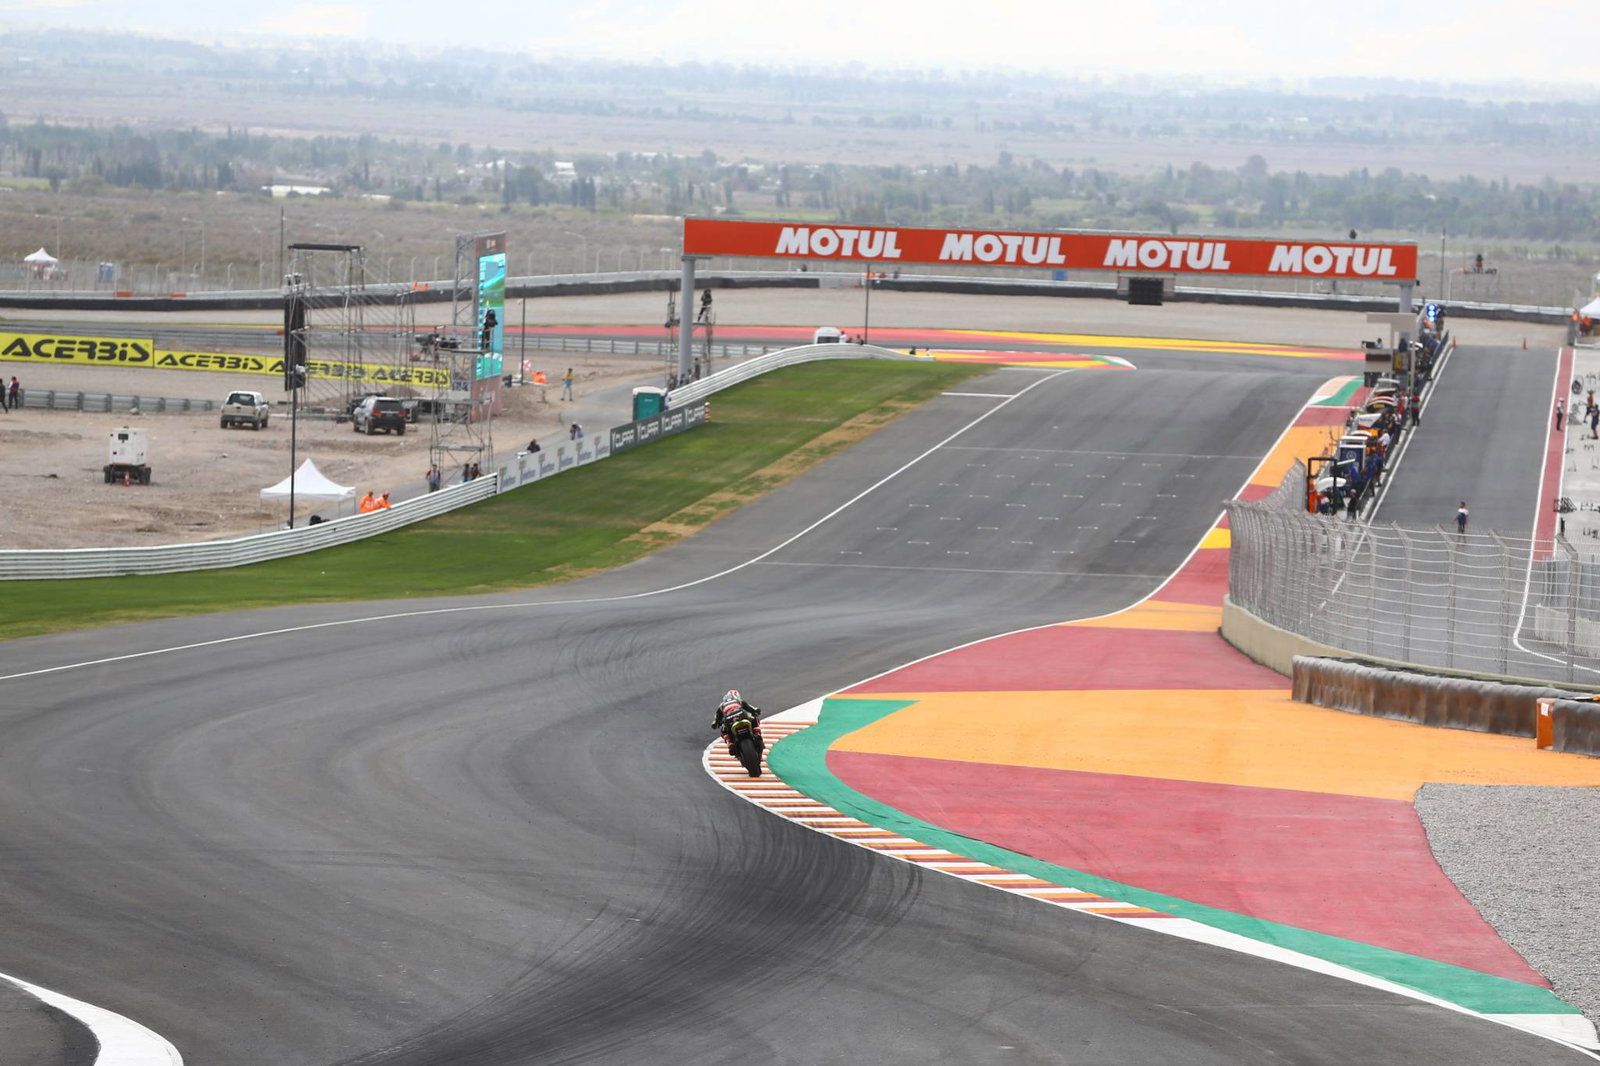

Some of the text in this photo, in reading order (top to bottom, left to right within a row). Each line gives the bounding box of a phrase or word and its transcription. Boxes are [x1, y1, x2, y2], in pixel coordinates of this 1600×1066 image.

[776, 227, 1397, 276] MOTUL MOTUL MOTUL MOTUL
